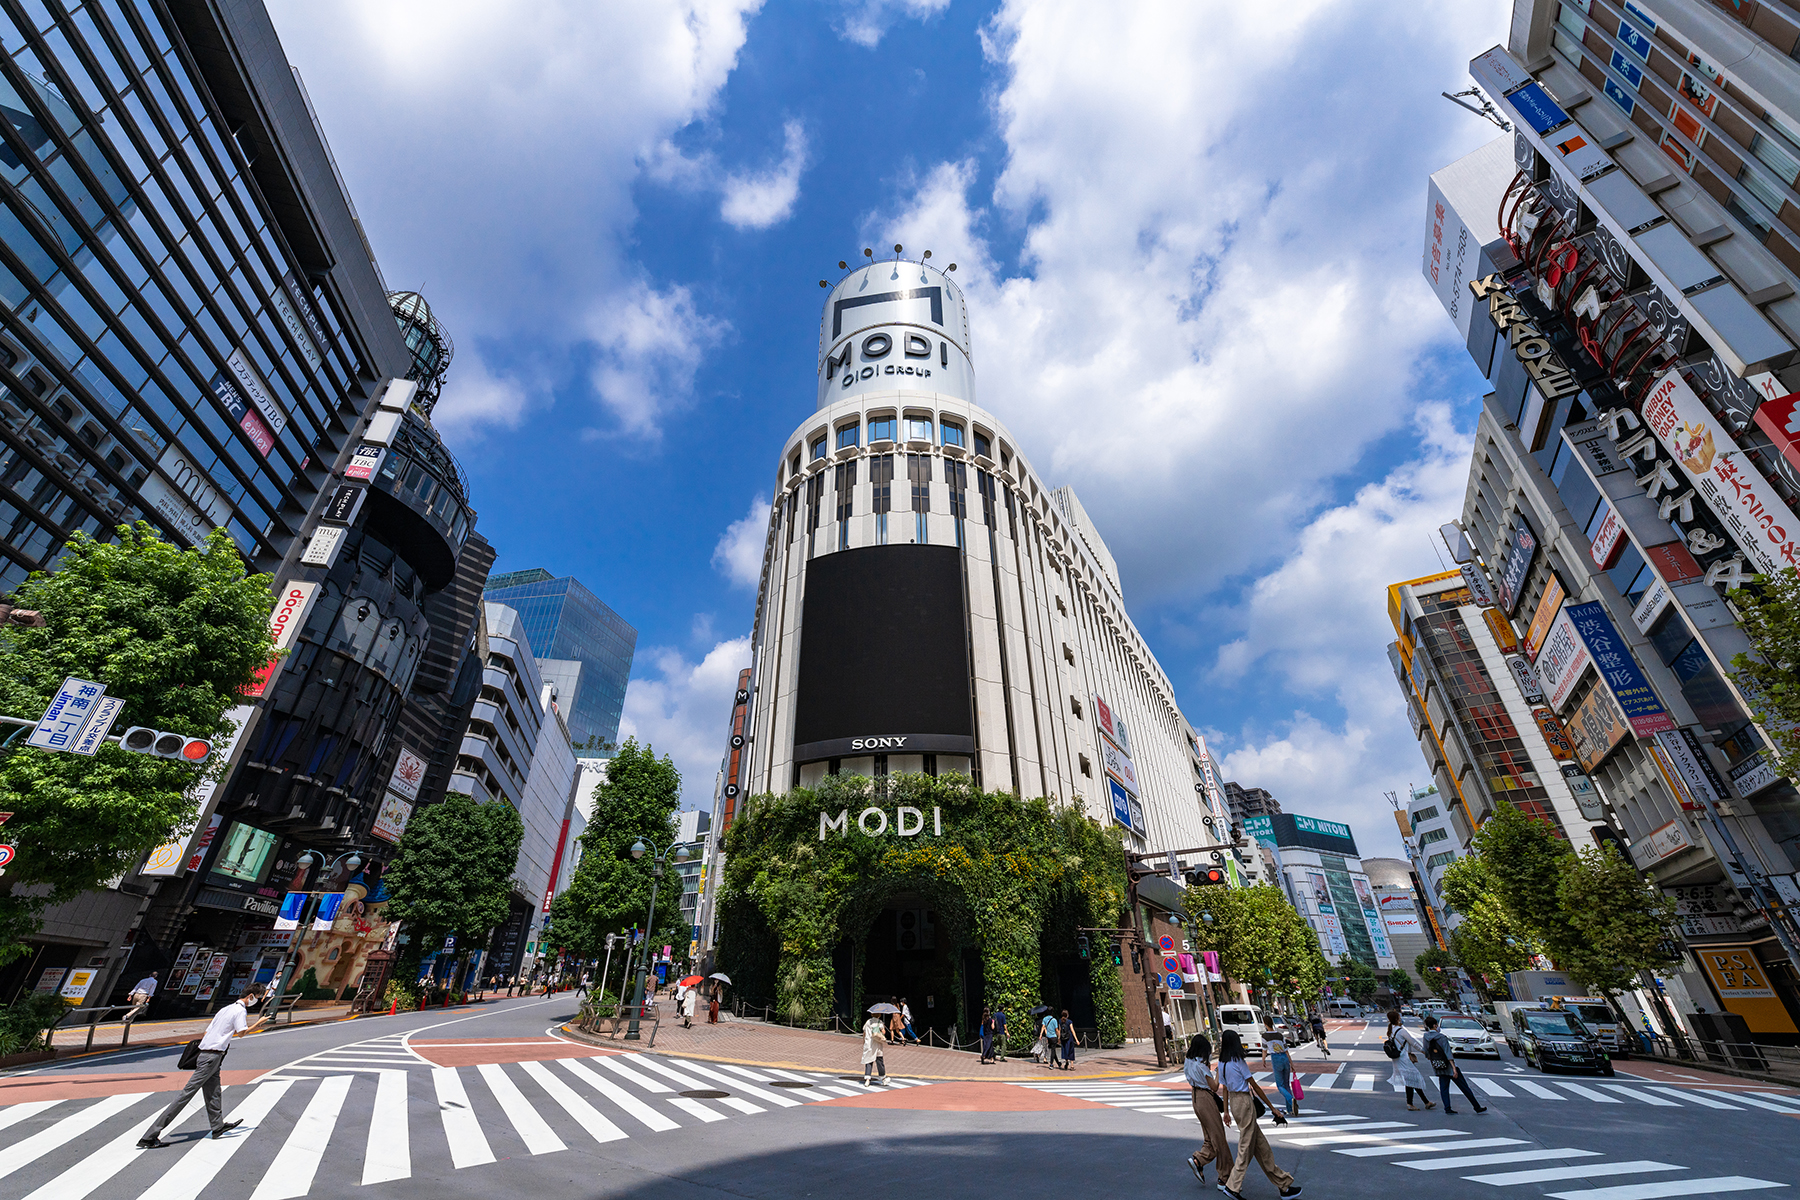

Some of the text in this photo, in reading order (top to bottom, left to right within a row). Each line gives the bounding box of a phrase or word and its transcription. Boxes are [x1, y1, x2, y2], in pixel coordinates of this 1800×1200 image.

[1450, 226, 1468, 319] 03-5774-7505
[289, 278, 328, 344] TECH PLAY
[277, 297, 317, 362] TECH PLAY
[1469, 272, 1581, 399] KARAOKE
[826, 332, 948, 380] MODI
[884, 365, 932, 379] GROUP
[214, 381, 242, 418] TBC
[224, 380, 243, 404] MEN'S
[1645, 379, 1676, 421] SHIBUYA
[1651, 396, 1675, 432] HONEY
[1658, 411, 1680, 441] TOAST
[354, 459, 375, 467] TBC
[1660, 545, 1688, 579] アイワホーム
[270, 590, 304, 645] docom
[1579, 619, 1633, 688] 渋谷整形
[46, 691, 73, 721] Jinnan
[1617, 686, 1649, 697] 美容外科
[49, 685, 98, 746] 神南一丁目
[851, 737, 907, 750] SONY
[580, 761, 608, 773] PARC
[1665, 732, 1711, 798] 渋谷サンクスクリニ
[819, 806, 942, 841] MODI
[1245, 818, 1271, 831] ニトリ
[1296, 816, 1348, 837] ニトリ NITORI
[244, 897, 279, 915] Pavilion
[1182, 940, 1190, 951] 5
